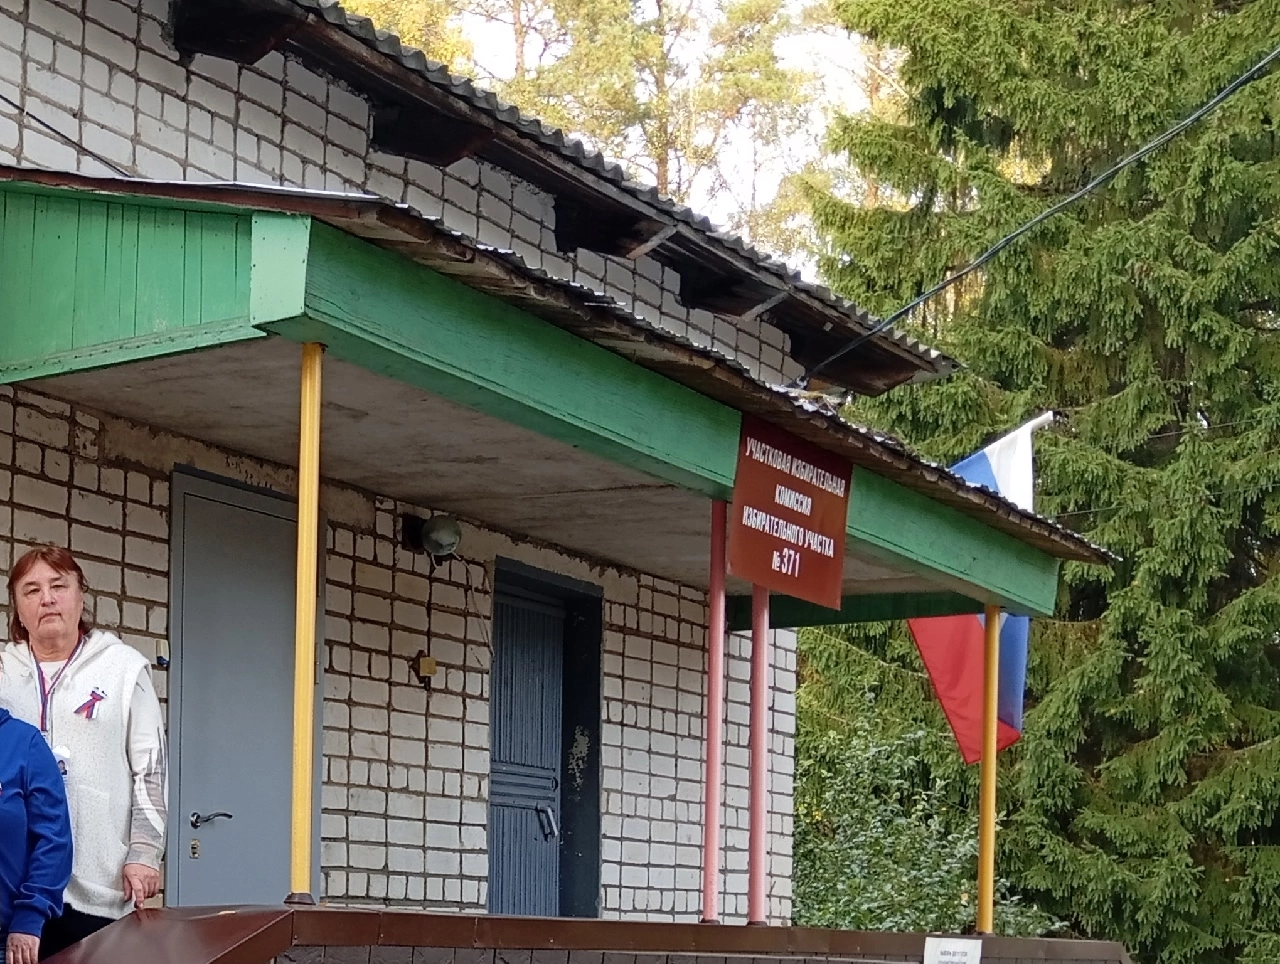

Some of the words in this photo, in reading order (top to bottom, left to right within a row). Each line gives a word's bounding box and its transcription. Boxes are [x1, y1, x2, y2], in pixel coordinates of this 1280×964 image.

[745, 436, 791, 474] УЧАСТКОВАЯ
[791, 457, 845, 498] ИЗБИРАТЕЛЬНАЯ
[774, 484, 812, 516] КОМИССИЯ
[742, 505, 804, 546] ИЗБИРАТЕЛЬНОГО
[804, 529, 834, 558] УЧАСТКА
[781, 548, 800, 578] 371
